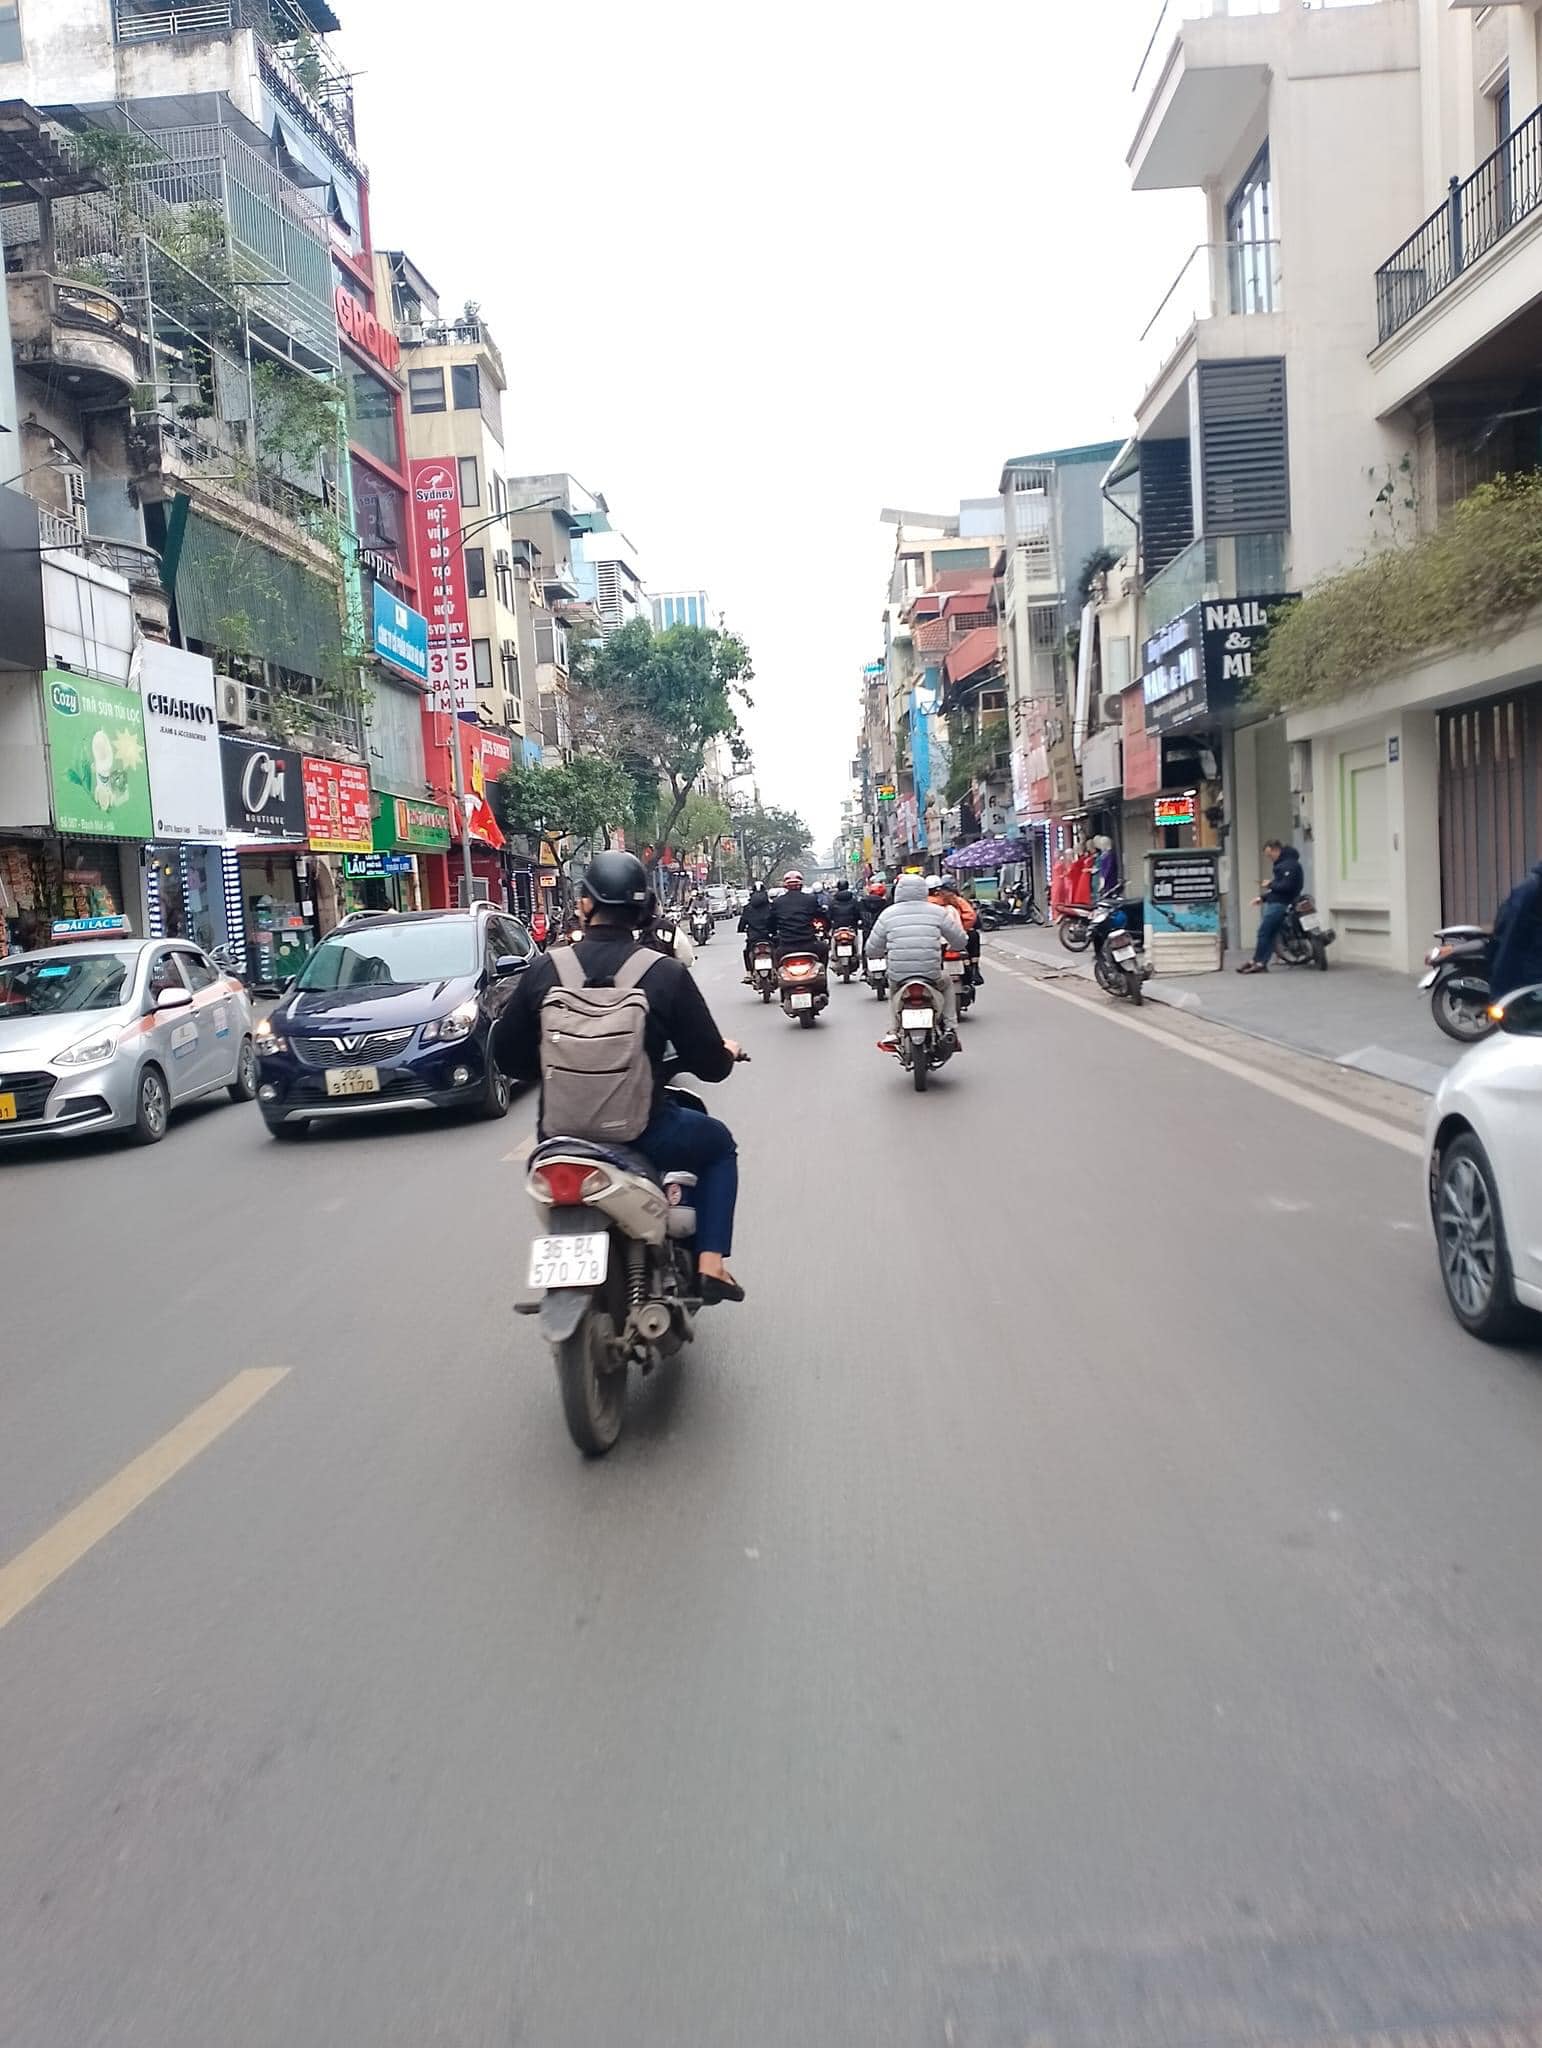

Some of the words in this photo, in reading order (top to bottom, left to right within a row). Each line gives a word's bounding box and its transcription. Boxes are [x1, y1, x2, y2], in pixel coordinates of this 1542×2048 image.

[336, 285, 400, 373] GROUP
[416, 488, 454, 502] Sydney
[1205, 602, 1267, 631] NAIL
[1225, 632, 1251, 649] &
[431, 652, 468, 673] 35
[1223, 653, 1253, 679] MI
[53, 687, 77, 713] Cozy
[147, 692, 215, 725] CHARIOT
[245, 814, 285, 825] BOUTIQUE
